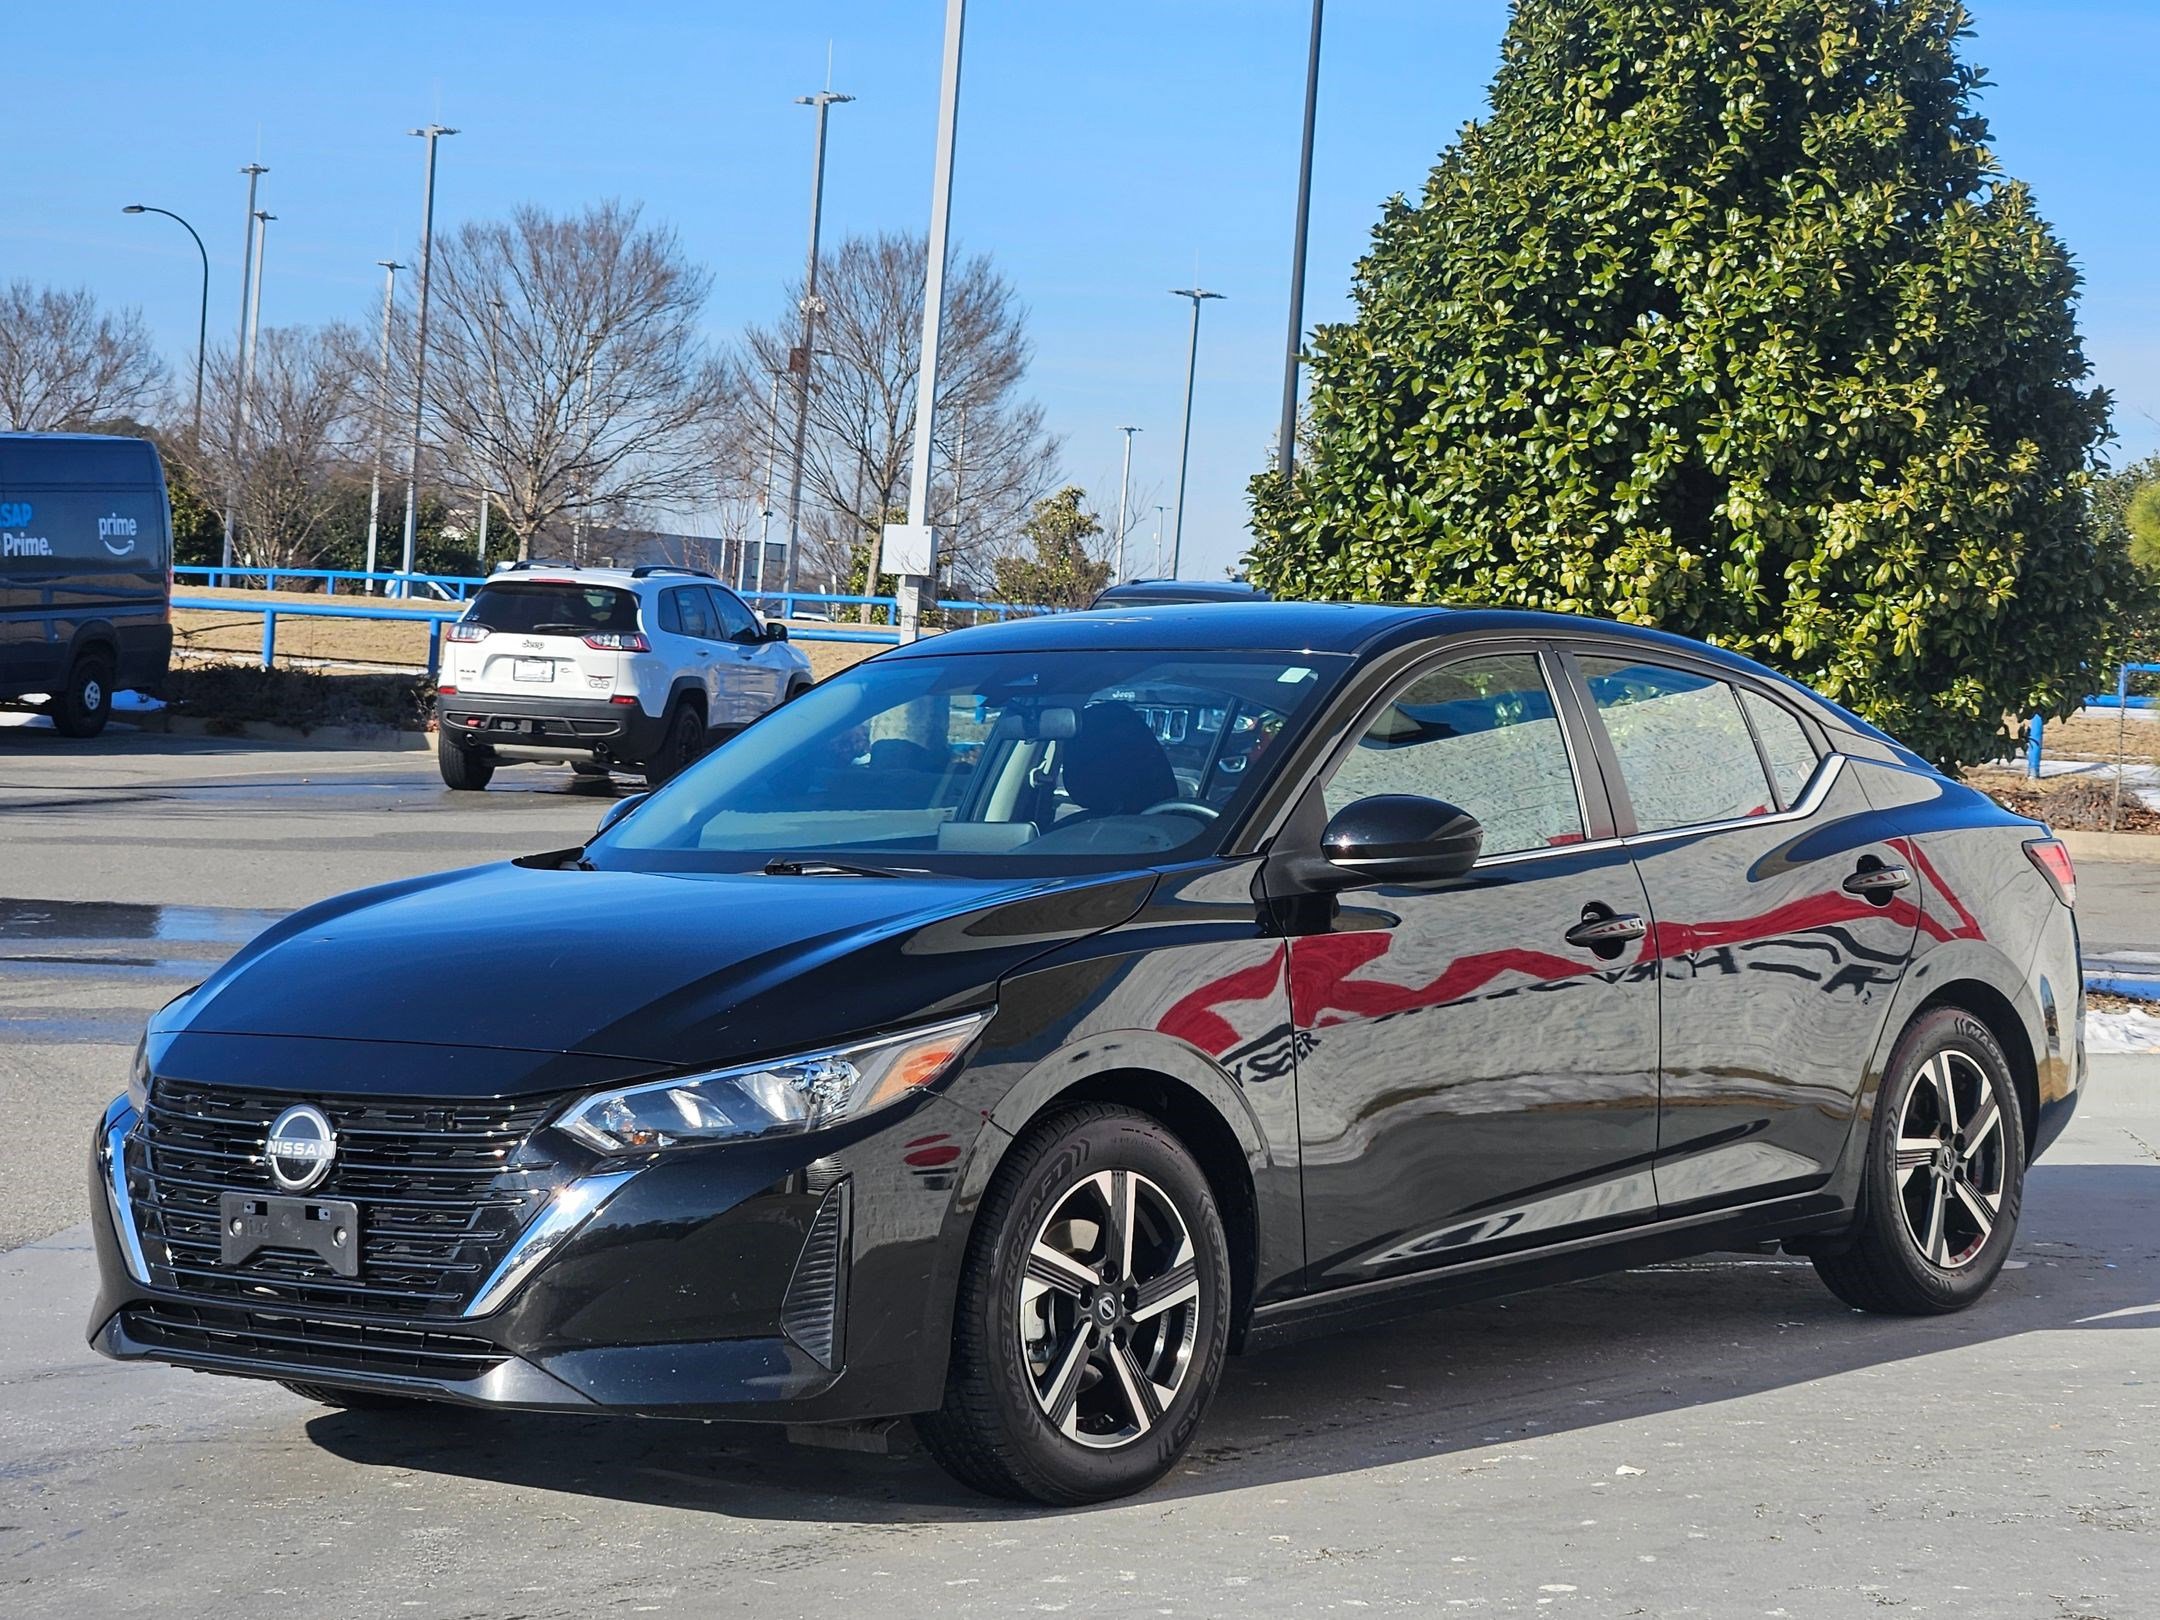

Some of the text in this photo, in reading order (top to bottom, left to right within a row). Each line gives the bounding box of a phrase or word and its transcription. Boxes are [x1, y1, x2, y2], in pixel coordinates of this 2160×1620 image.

[0, 503, 32, 527] SAP
[98, 512, 137, 540] prime
[3, 532, 53, 557] Prime.
[522, 639, 544, 650] Jeep
[1112, 689, 1136, 702] Jeep
[267, 1140, 336, 1158] NISSAN
[1000, 1156, 1067, 1414] MASTERCRAFT
[1204, 1230, 1228, 1386] STRATUS
